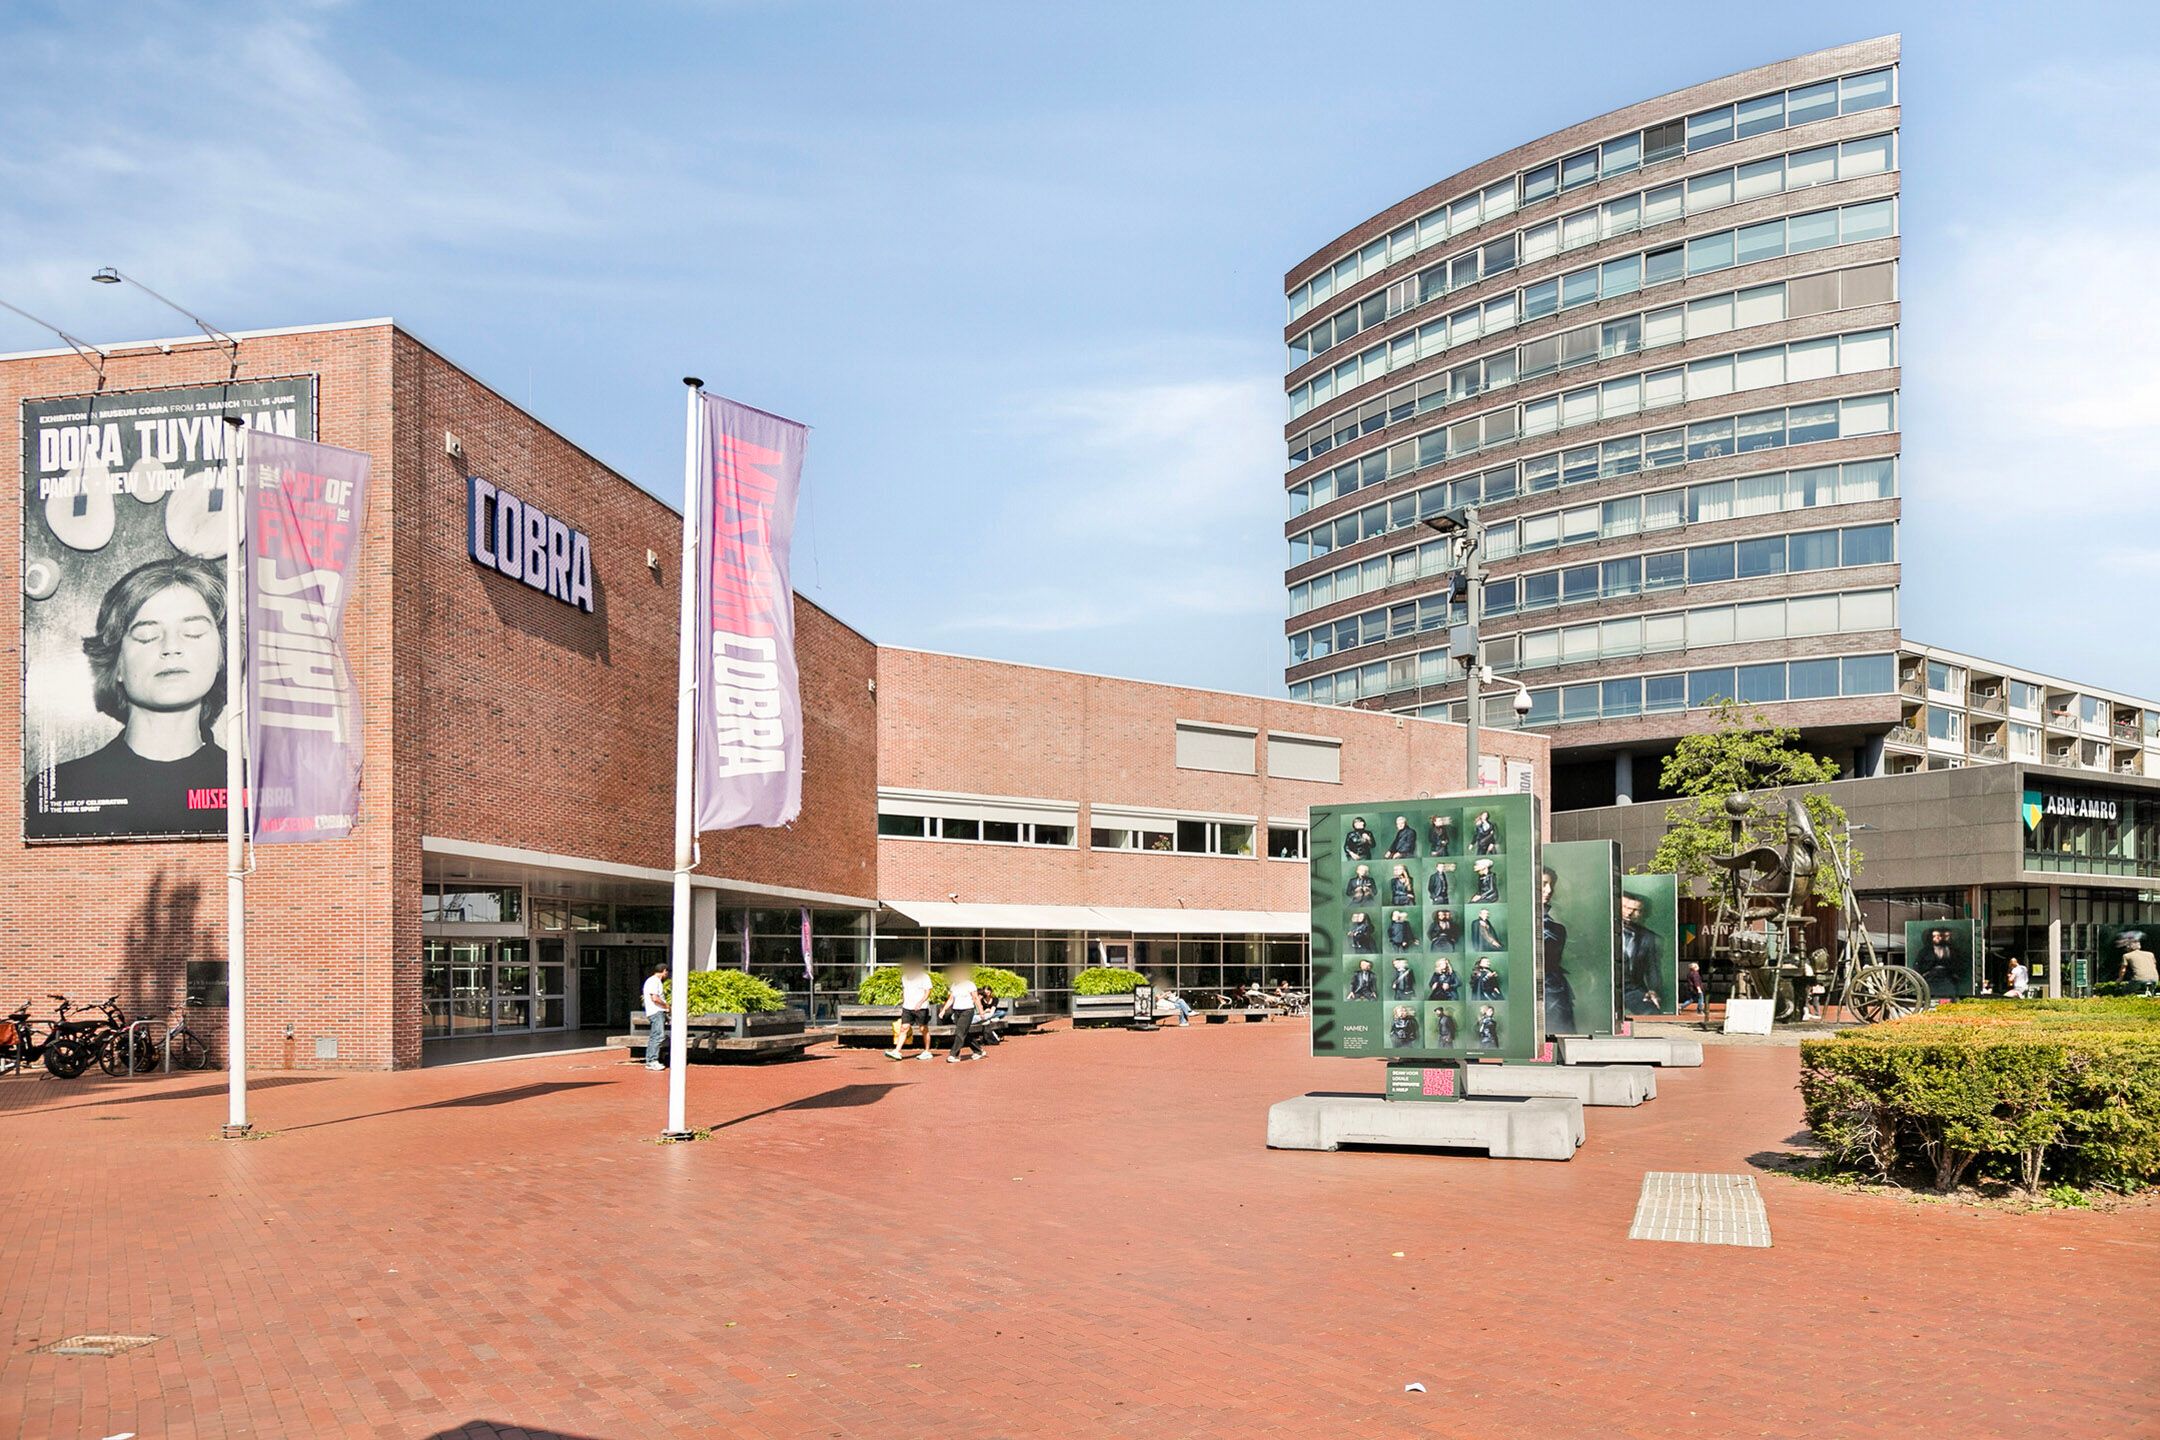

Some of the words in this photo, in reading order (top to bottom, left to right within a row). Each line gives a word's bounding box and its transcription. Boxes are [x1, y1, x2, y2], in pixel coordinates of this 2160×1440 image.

[39, 412, 87, 424] EXHIBITION
[99, 408, 137, 419] MUSEUM
[138, 405, 169, 416] COBRA
[170, 403, 194, 413] FROM
[195, 402, 207, 411] 22
[208, 400, 240, 410] MARCH
[242, 398, 259, 407] TILL
[261, 398, 271, 406] 15
[271, 395, 296, 405] JUNE
[39, 422, 124, 472] DORA
[105, 470, 140, 495] NEW
[144, 467, 187, 491] YORK
[281, 468, 326, 501] ART
[325, 478, 353, 505] OF
[469, 476, 594, 614] COBRA
[258, 557, 351, 743] SPIRIT
